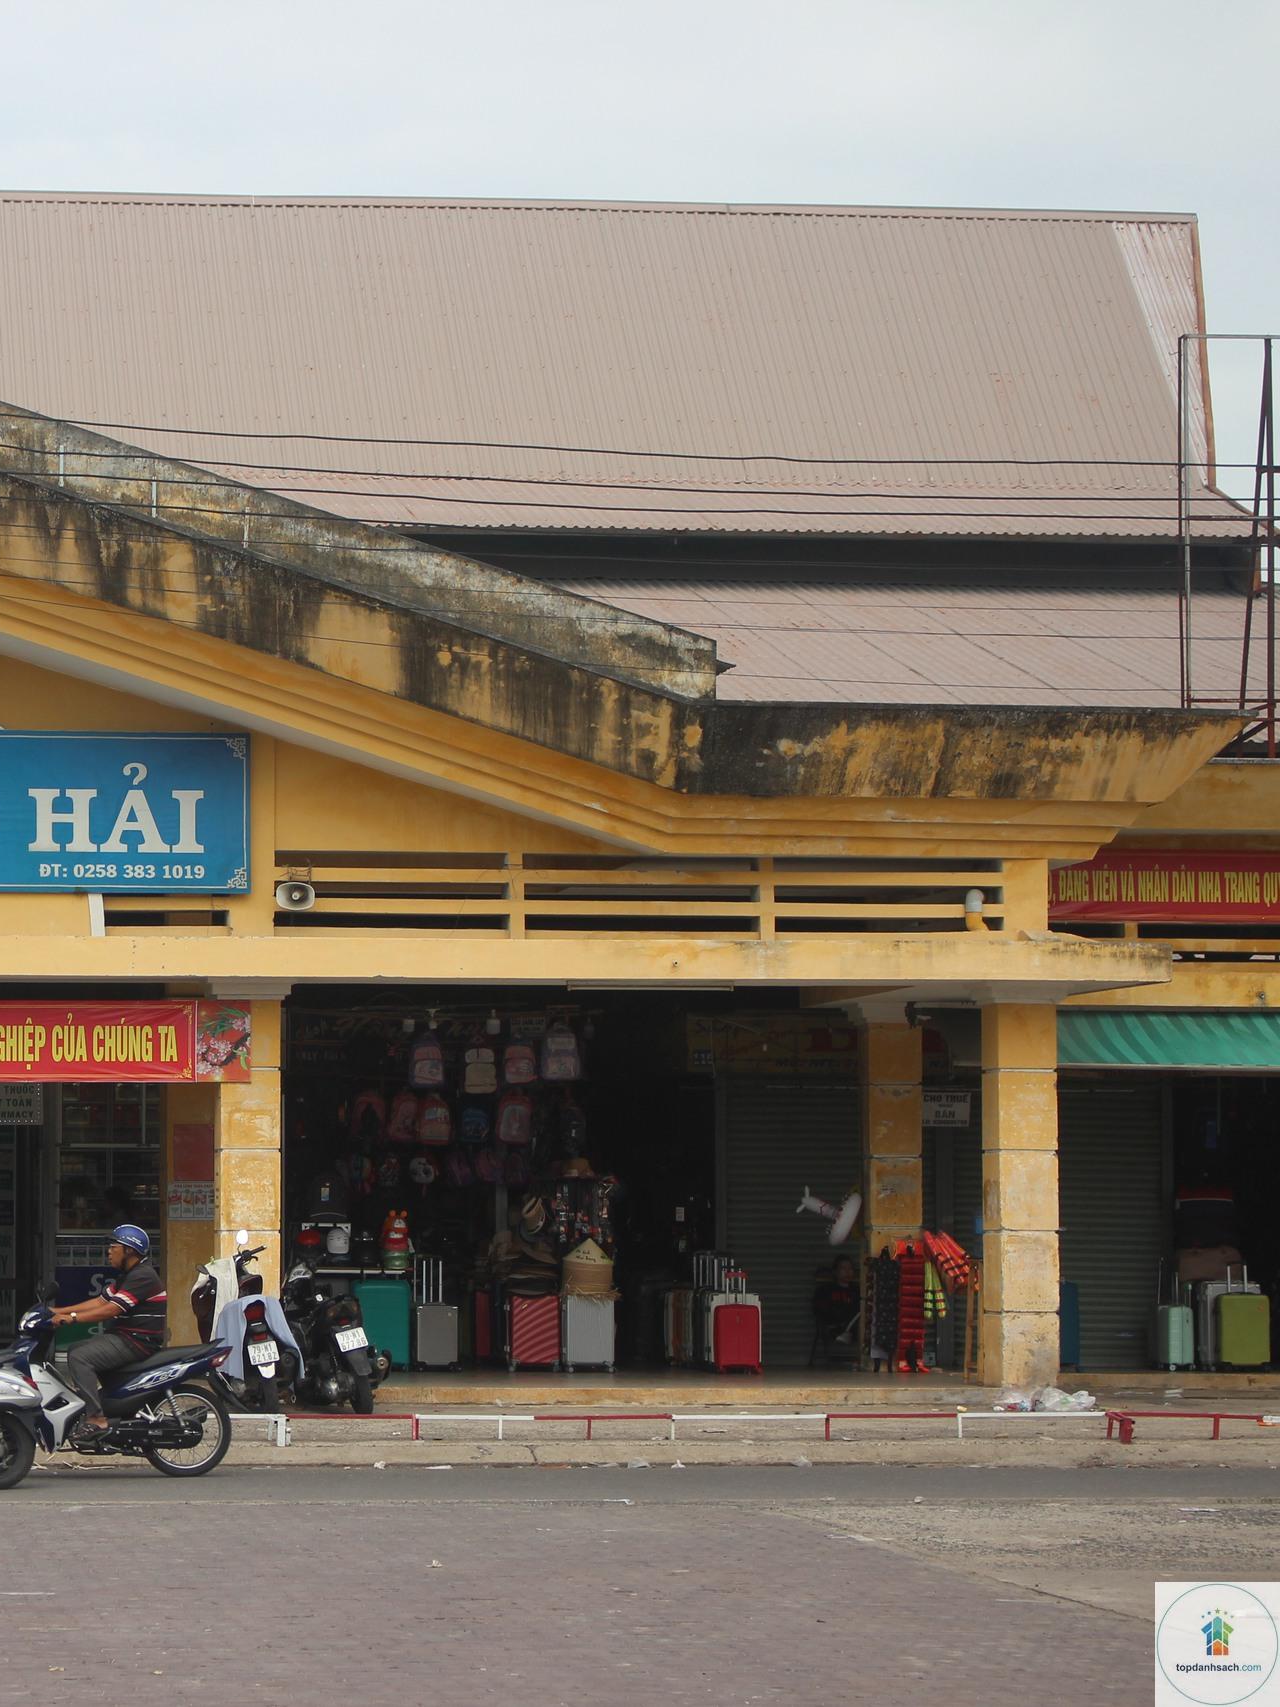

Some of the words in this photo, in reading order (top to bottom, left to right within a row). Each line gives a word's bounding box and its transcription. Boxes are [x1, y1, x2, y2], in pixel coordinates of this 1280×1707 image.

[28, 762, 205, 855] HẢI
[39, 863, 68, 878] ĐT:
[73, 863, 118, 878] 0258
[123, 864, 156, 879] 383
[162, 864, 205, 879] 1019
[1093, 863, 1118, 902] VIÊN
[1121, 863, 1136, 902] VÀ
[1138, 863, 1169, 903] NHÂN
[1172, 864, 1196, 903] DÂN
[1198, 871, 1222, 903] NHA
[1224, 871, 1261, 904] TRANG
[1263, 871, 1280, 908] QU
[51, 1012, 88, 1062] CỦA
[92, 1017, 153, 1063] CHÚNG
[157, 1025, 179, 1062] TA
